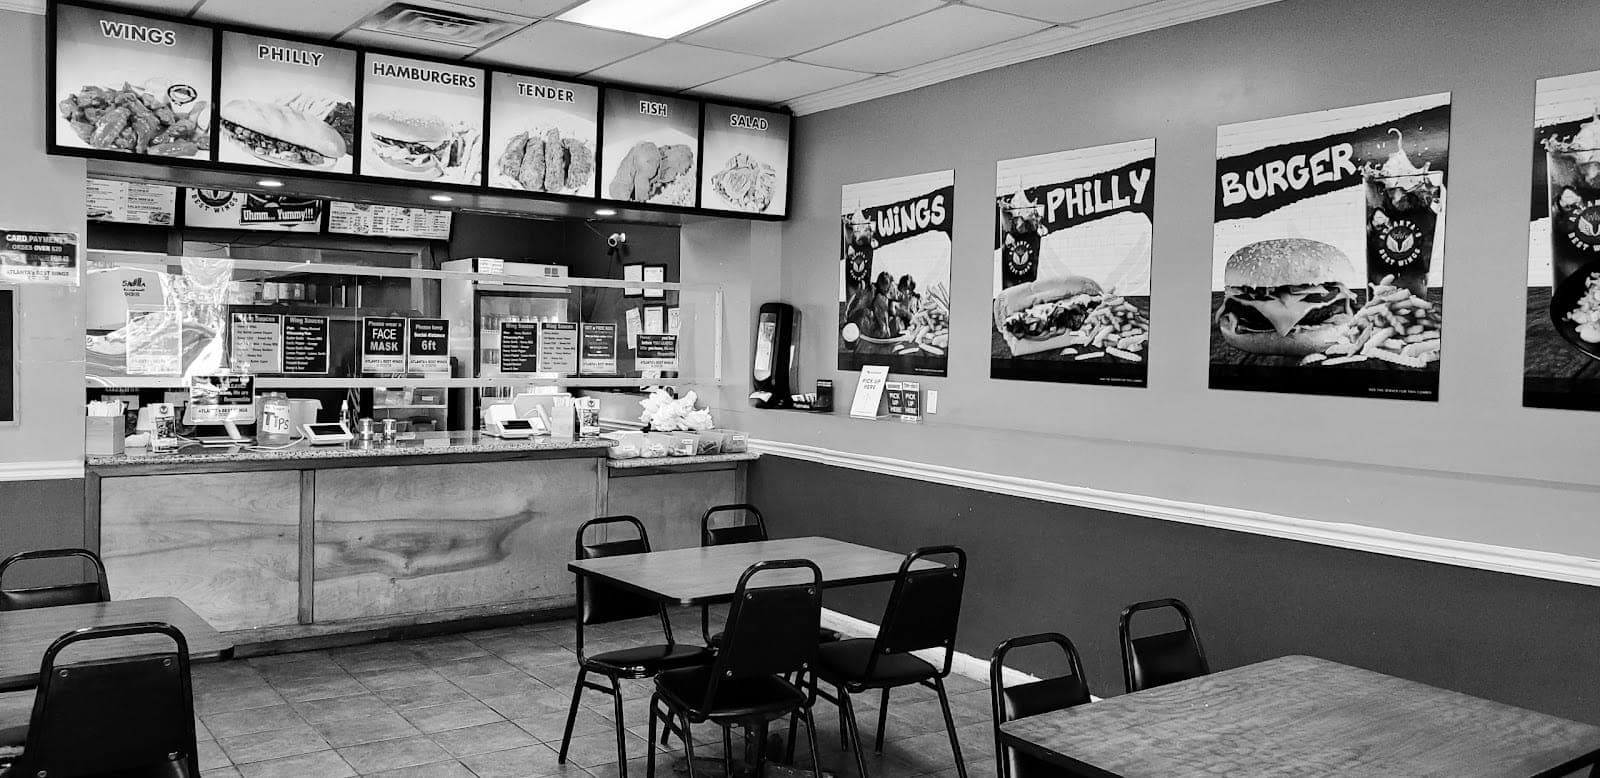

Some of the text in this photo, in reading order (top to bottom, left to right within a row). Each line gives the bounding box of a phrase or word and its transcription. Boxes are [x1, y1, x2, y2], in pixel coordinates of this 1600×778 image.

[100, 20, 176, 46] WINGS
[257, 44, 324, 67] PHILLY
[373, 62, 478, 88] HAMBURGERS
[517, 83, 575, 103] TENDER
[639, 100, 668, 117] FISH
[730, 113, 768, 131] SALAD
[1221, 142, 1357, 207] BURGER
[191, 194, 238, 213] BEST WINGS
[277, 207, 313, 222] Yummy!!!
[6, 234, 27, 242] CARD
[1568, 232, 1590, 250] BEST
[1379, 248, 1421, 267] BEST WINGS
[372, 328, 397, 340] FACE
[370, 340, 399, 351] MASK
[421, 340, 437, 351] 6ft
